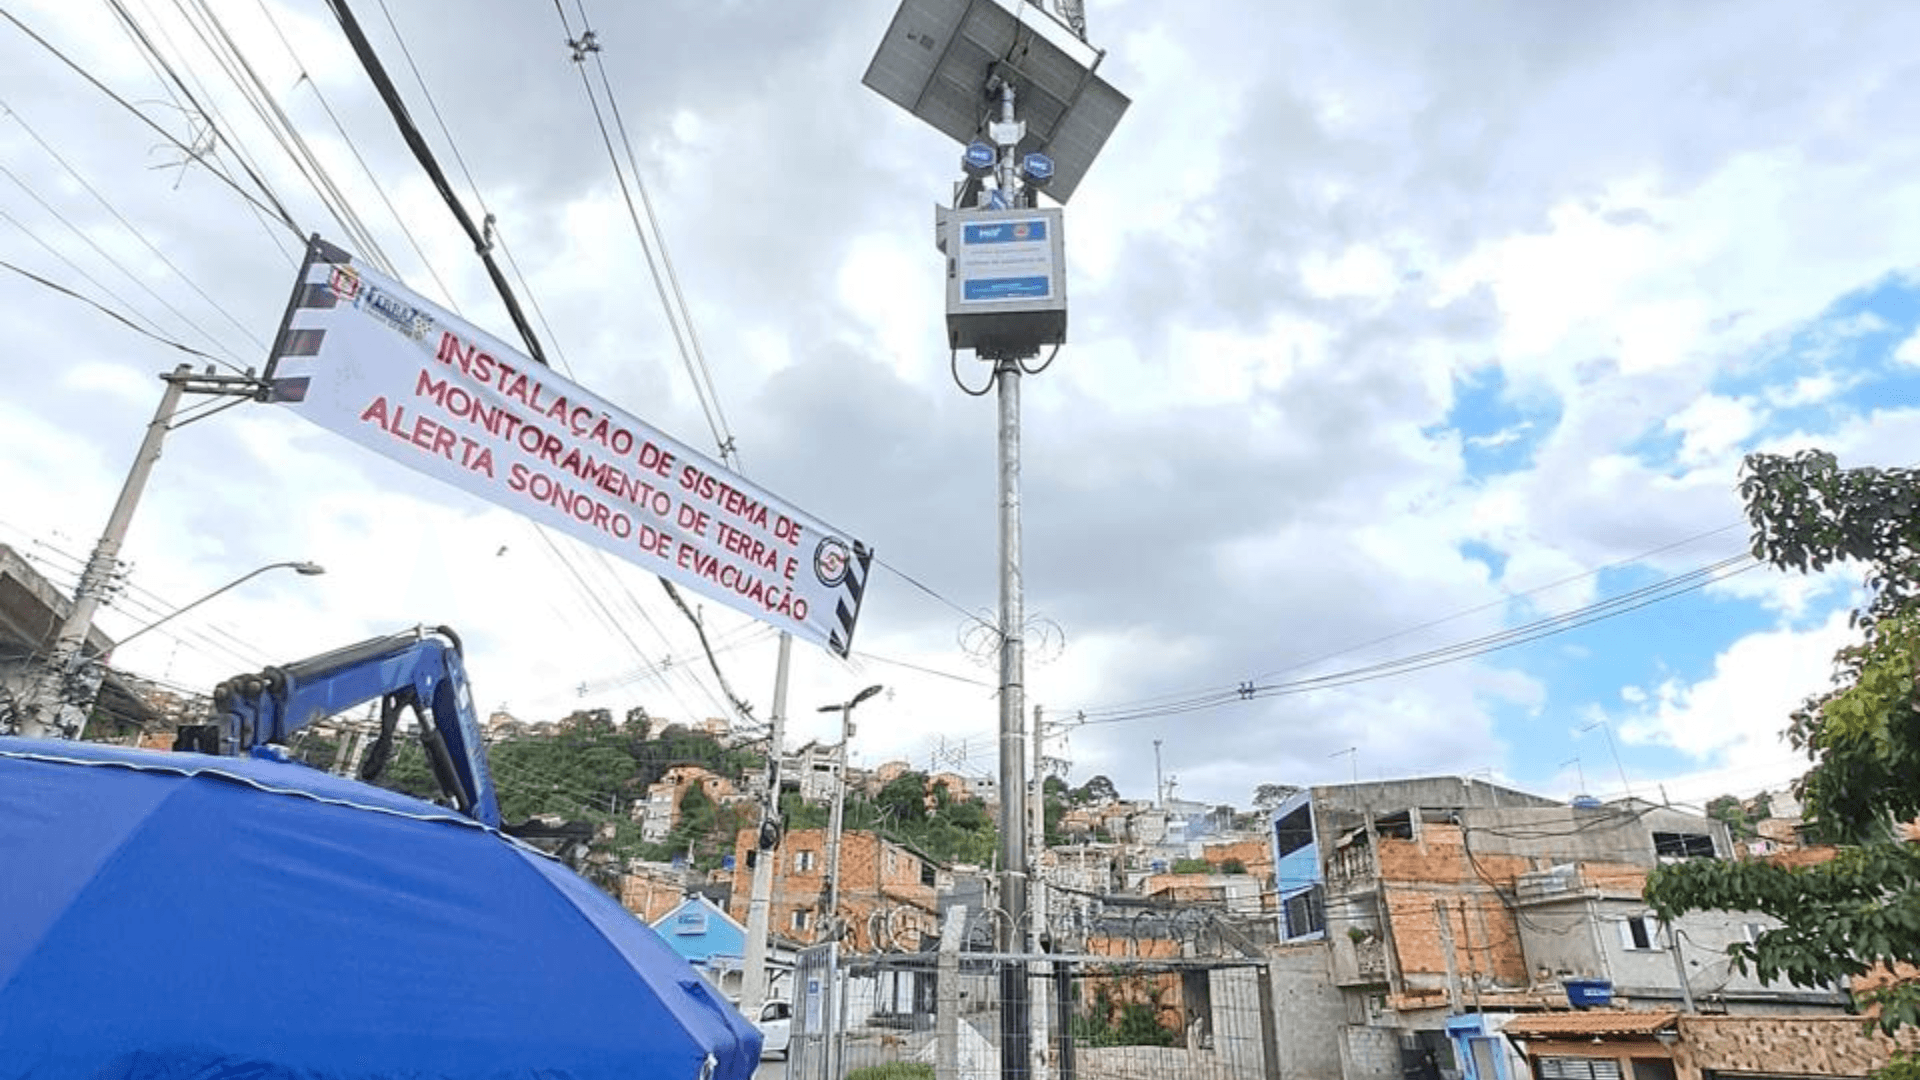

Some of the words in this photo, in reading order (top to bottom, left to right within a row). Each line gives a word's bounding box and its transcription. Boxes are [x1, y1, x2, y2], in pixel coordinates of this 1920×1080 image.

[360, 396, 494, 479] ALERTA
[507, 462, 632, 539] SONORO
[639, 523, 674, 560] DE
[677, 542, 808, 622] EVACUAÇÃO
[415, 368, 672, 517] MONITORAMENTO
[677, 502, 711, 537] DE
[717, 520, 778, 572] TERRA
[783, 556, 799, 581] E
[436, 330, 634, 455] INSTALAÇÃO
[638, 441, 677, 478] DE
[679, 465, 769, 530] SISTEMA
[774, 515, 803, 547] DE
